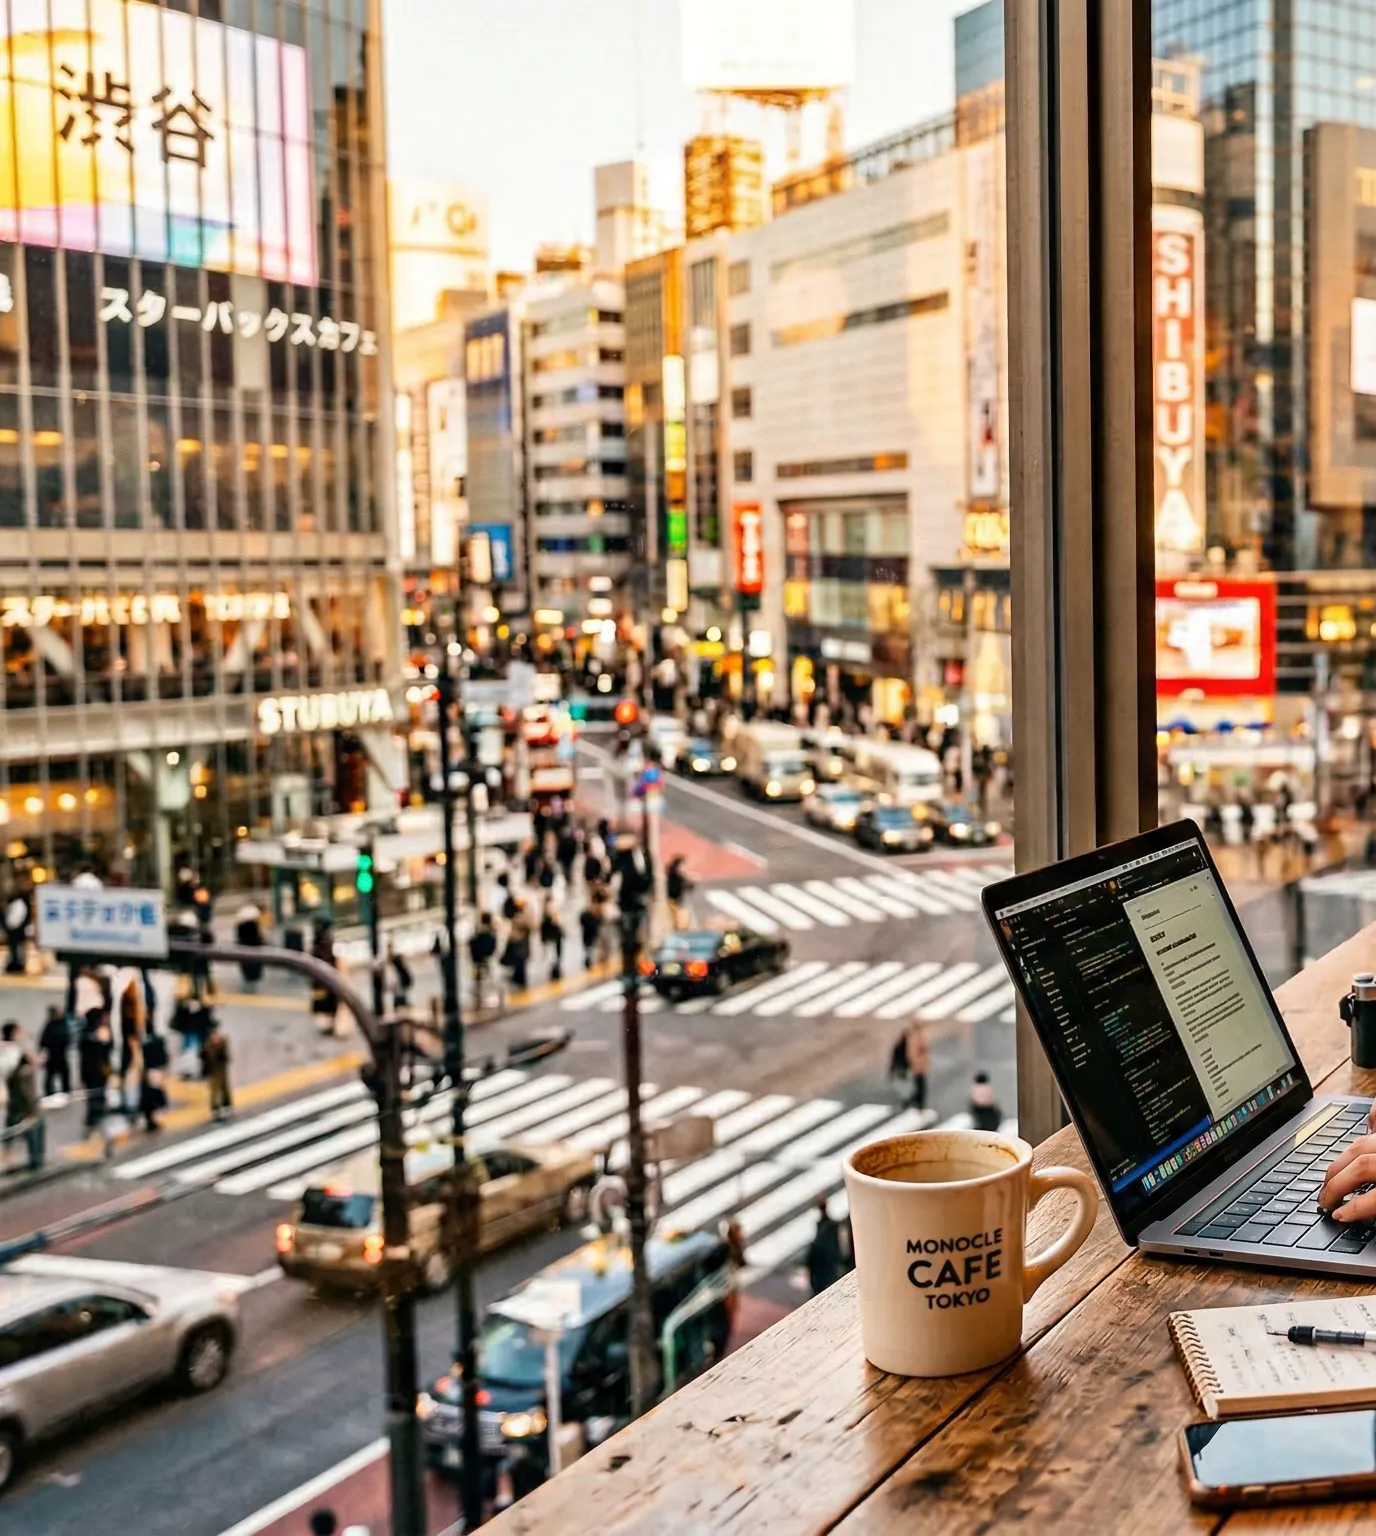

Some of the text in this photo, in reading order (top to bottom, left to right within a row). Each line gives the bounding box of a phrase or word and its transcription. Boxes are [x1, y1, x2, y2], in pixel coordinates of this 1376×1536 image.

[60, 64, 214, 168] 渋谷
[1155, 233, 1199, 545] SHIBUYA
[906, 1227, 1003, 1254] MONOCLE
[907, 1249, 1002, 1288] CAFE
[925, 1287, 990, 1310] TOKYO
